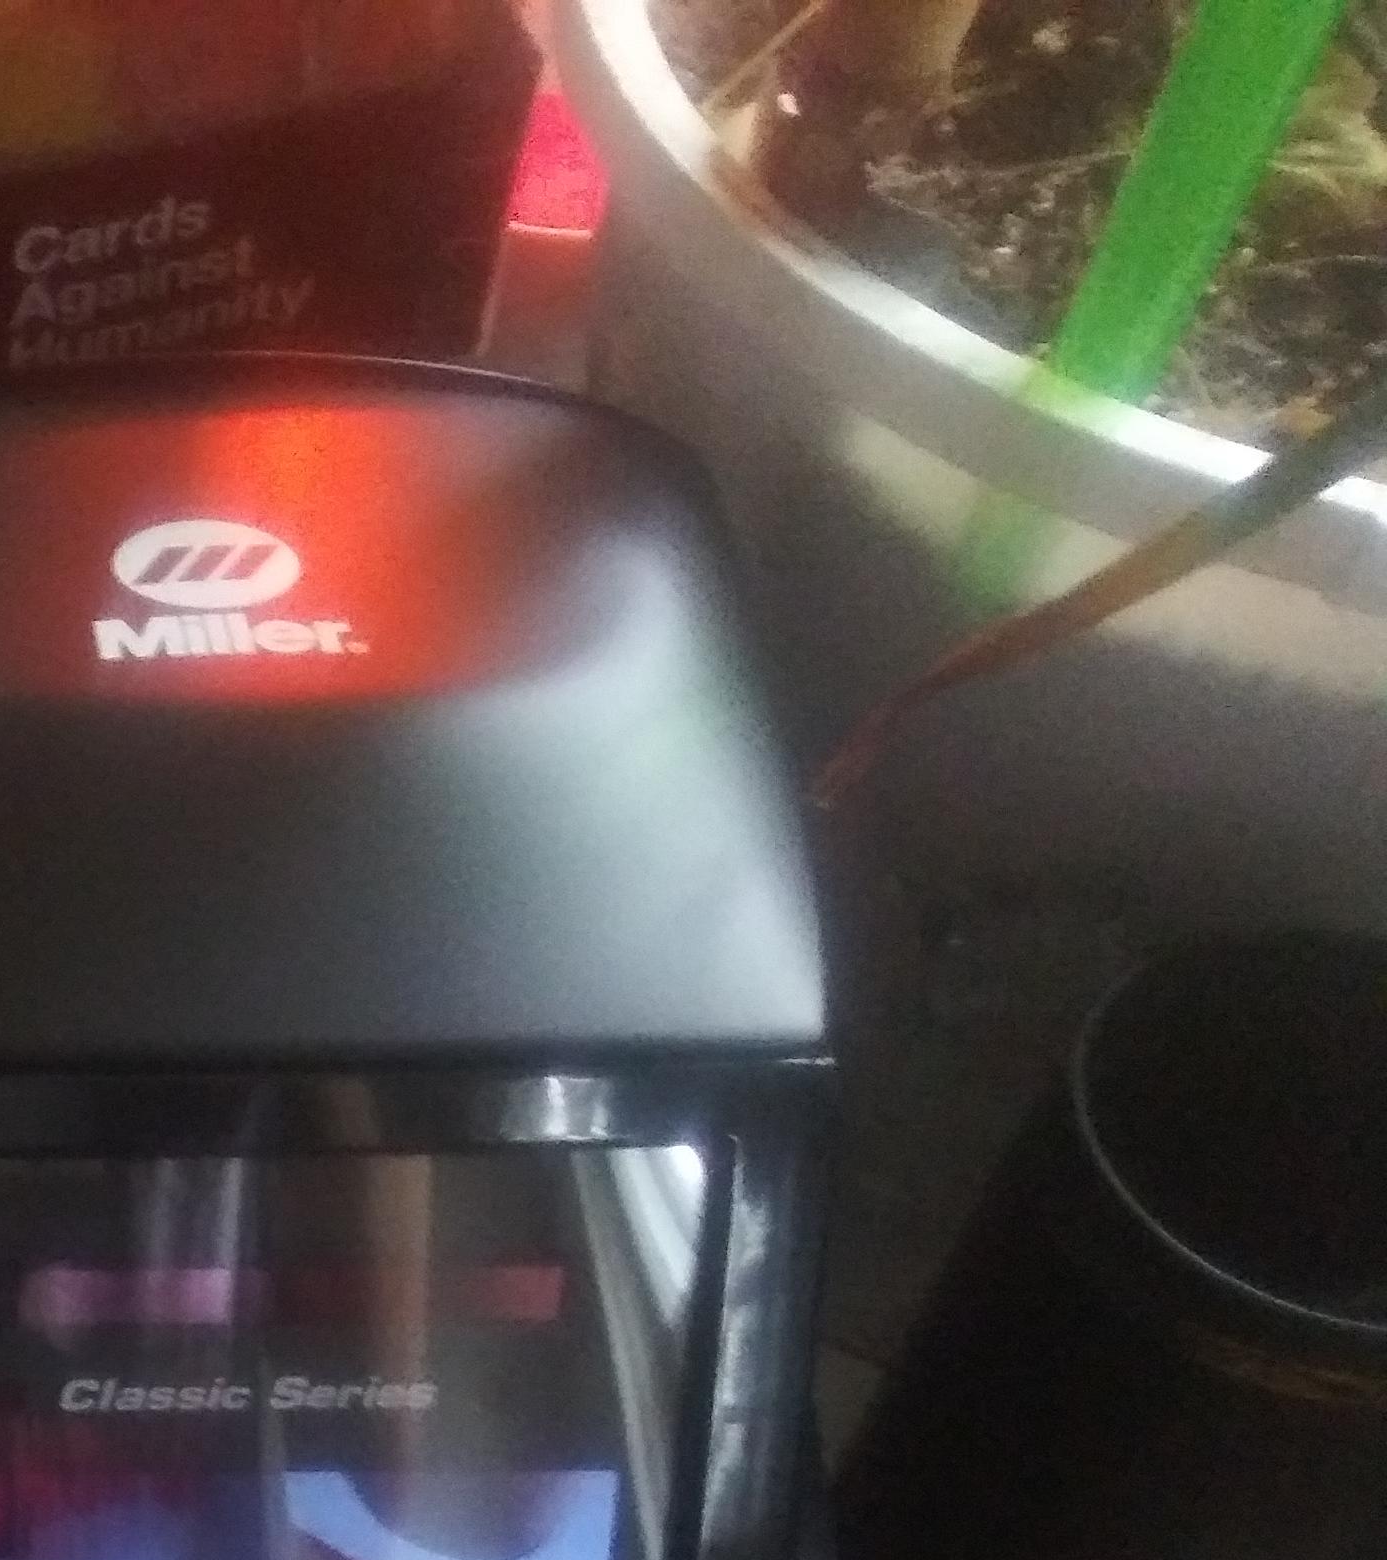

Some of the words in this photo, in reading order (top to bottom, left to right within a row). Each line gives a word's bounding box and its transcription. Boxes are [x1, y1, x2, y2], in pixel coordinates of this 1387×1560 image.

[14, 196, 212, 274] Cards
[10, 236, 255, 329] Against
[58, 1376, 252, 1412] Classic
[270, 1375, 440, 1411] Series
